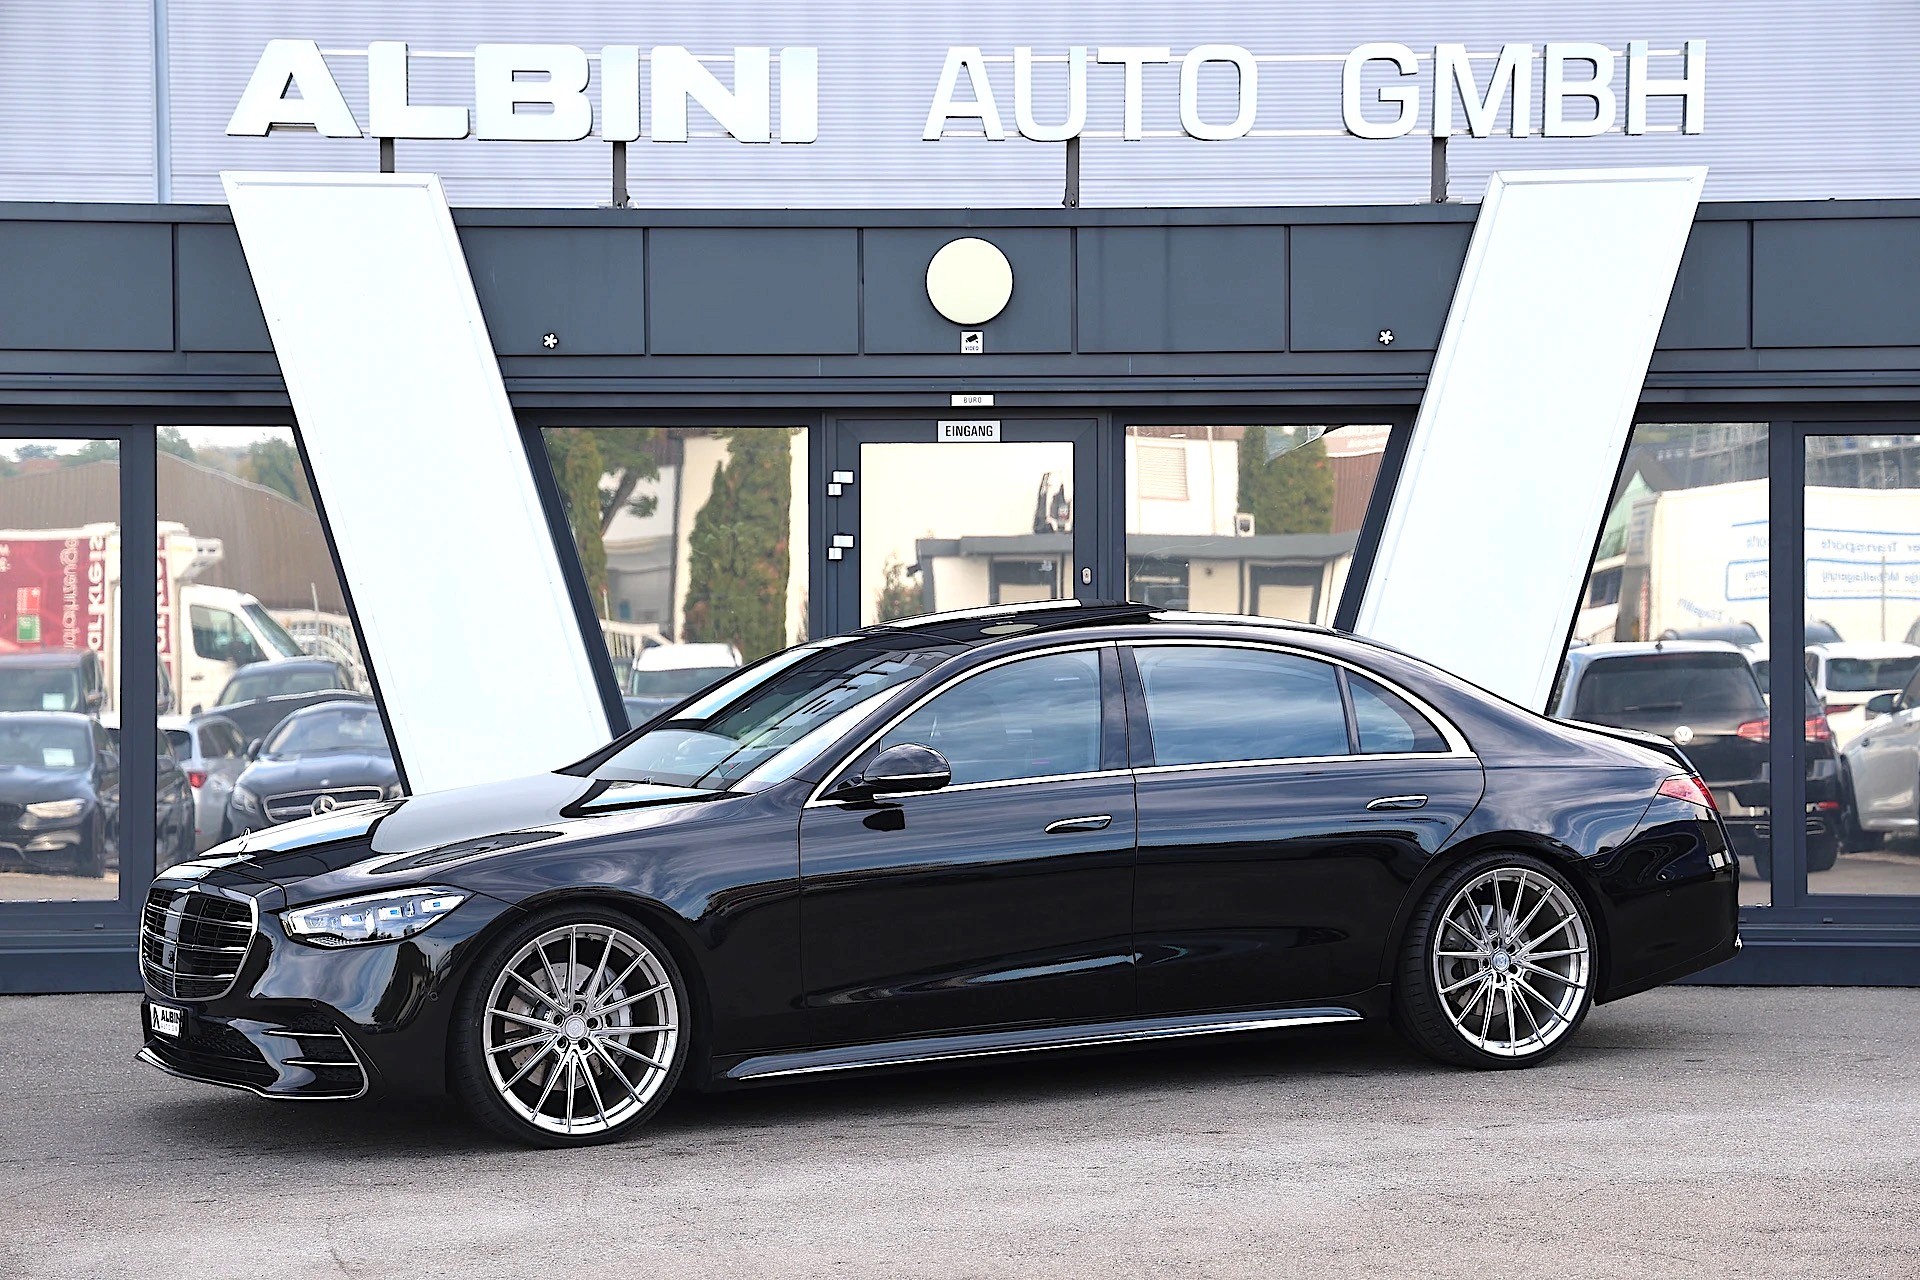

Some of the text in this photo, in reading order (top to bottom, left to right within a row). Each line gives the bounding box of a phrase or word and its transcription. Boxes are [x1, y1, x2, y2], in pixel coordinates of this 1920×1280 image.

[225, 38, 1707, 143] ALBINI AUTO GMBH
[945, 425, 993, 437] EINGANG
